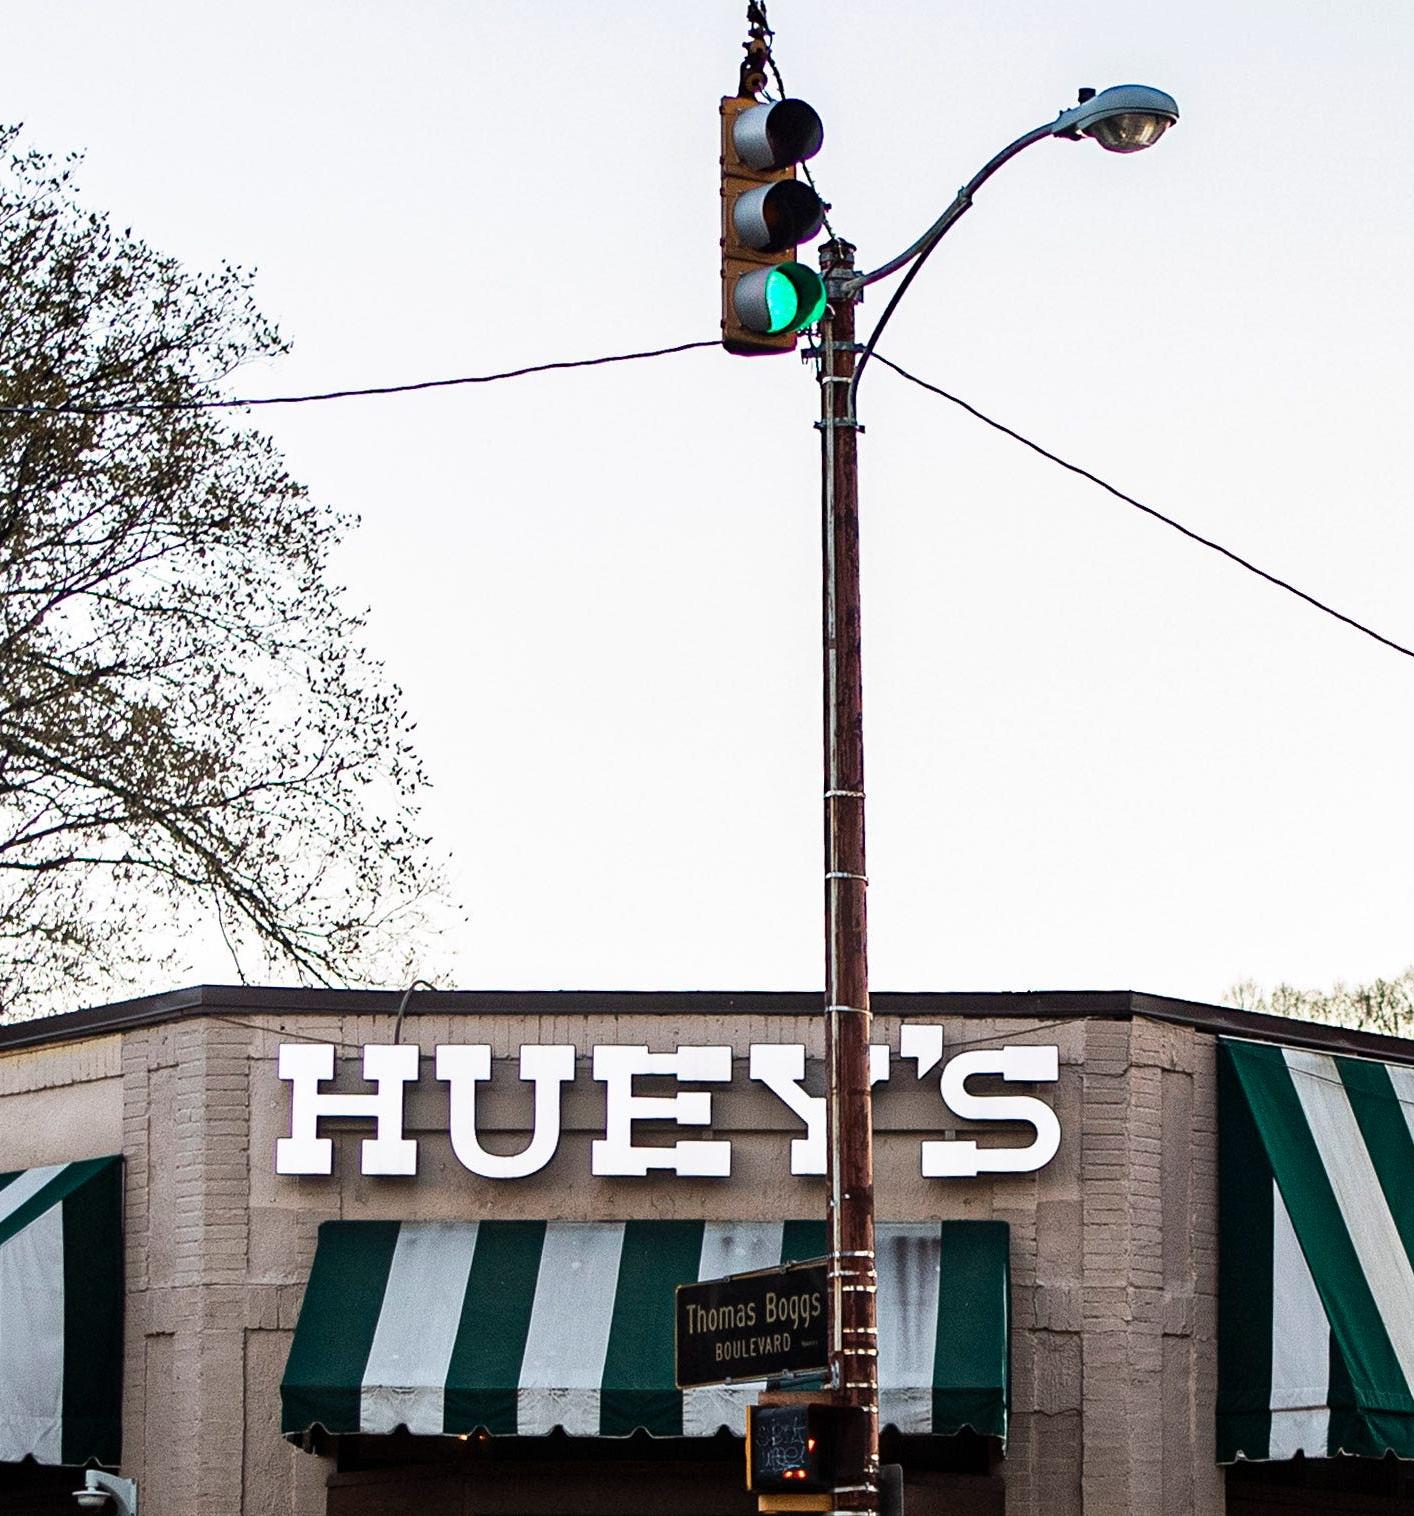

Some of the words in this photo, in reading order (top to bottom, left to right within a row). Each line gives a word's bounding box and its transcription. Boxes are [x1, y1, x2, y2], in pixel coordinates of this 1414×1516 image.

[275, 1023, 1062, 1179] HUEY'S
[686, 1302, 756, 1335] Thomas
[765, 1291, 821, 1330] Boggs
[715, 1333, 791, 1362] BOULEVARD
